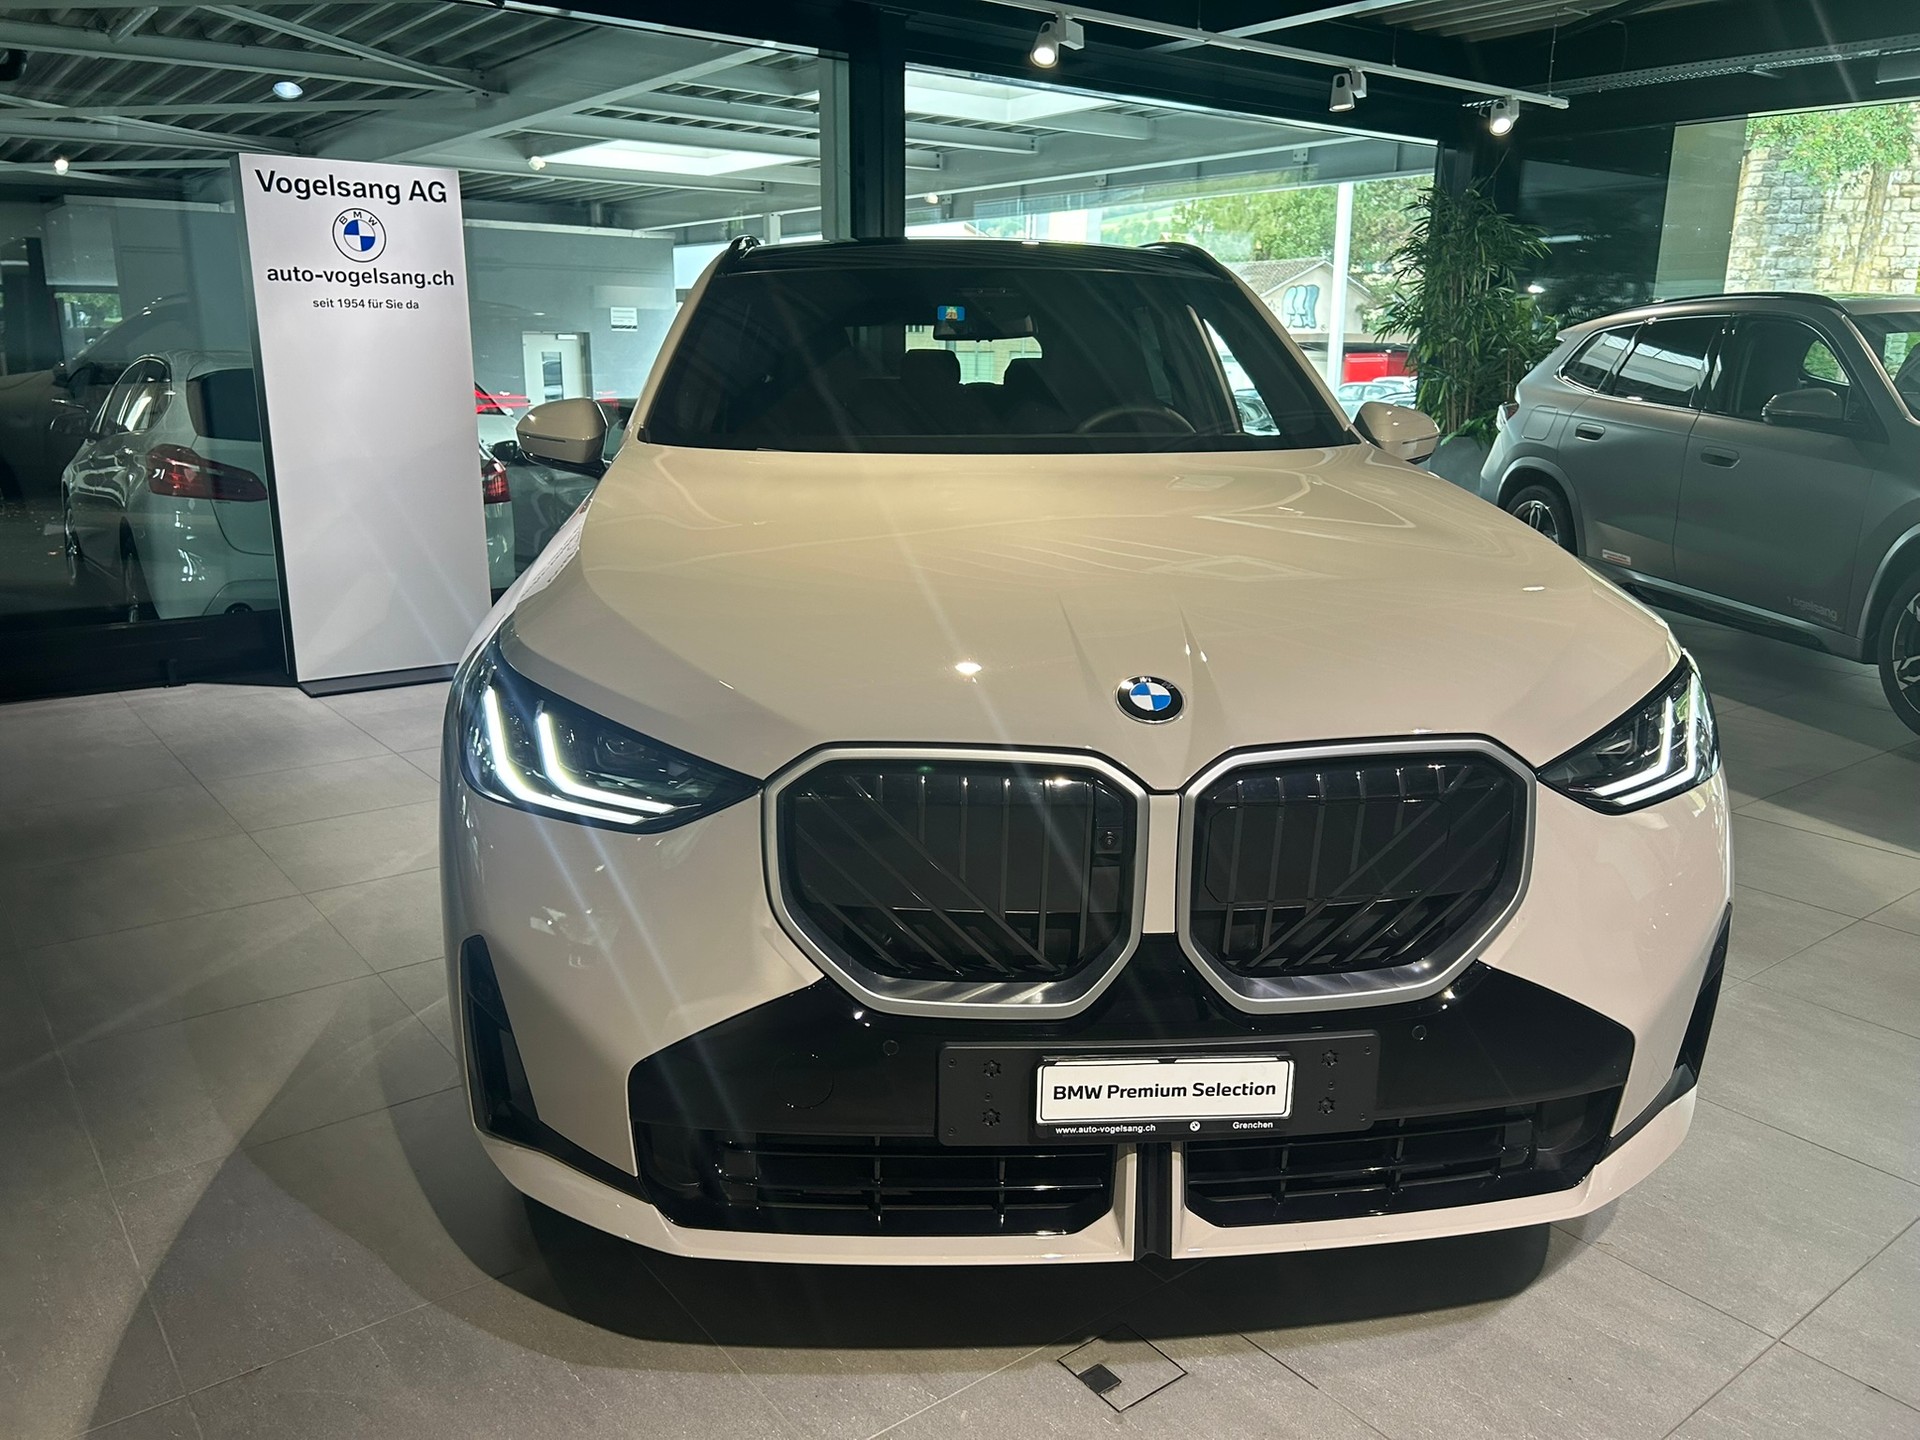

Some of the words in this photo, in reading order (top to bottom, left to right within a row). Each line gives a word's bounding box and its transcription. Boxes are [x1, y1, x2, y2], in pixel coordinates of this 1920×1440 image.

[254, 168, 401, 206] Vogelsang
[408, 180, 448, 203] AG
[338, 210, 378, 227] BMW
[266, 266, 455, 289] auto-vogelsang.ch
[312, 298, 335, 308] seit
[337, 299, 366, 309] 1954
[367, 299, 384, 309] für
[385, 299, 404, 310] Sie
[405, 300, 420, 310] da
[1053, 1084, 1103, 1100] BMW
[1107, 1083, 1188, 1099] Premium
[1192, 1081, 1276, 1098] Selection
[1055, 1123, 1156, 1135] www.auto-vogelsang.ch
[1232, 1120, 1274, 1130] Grenchen
